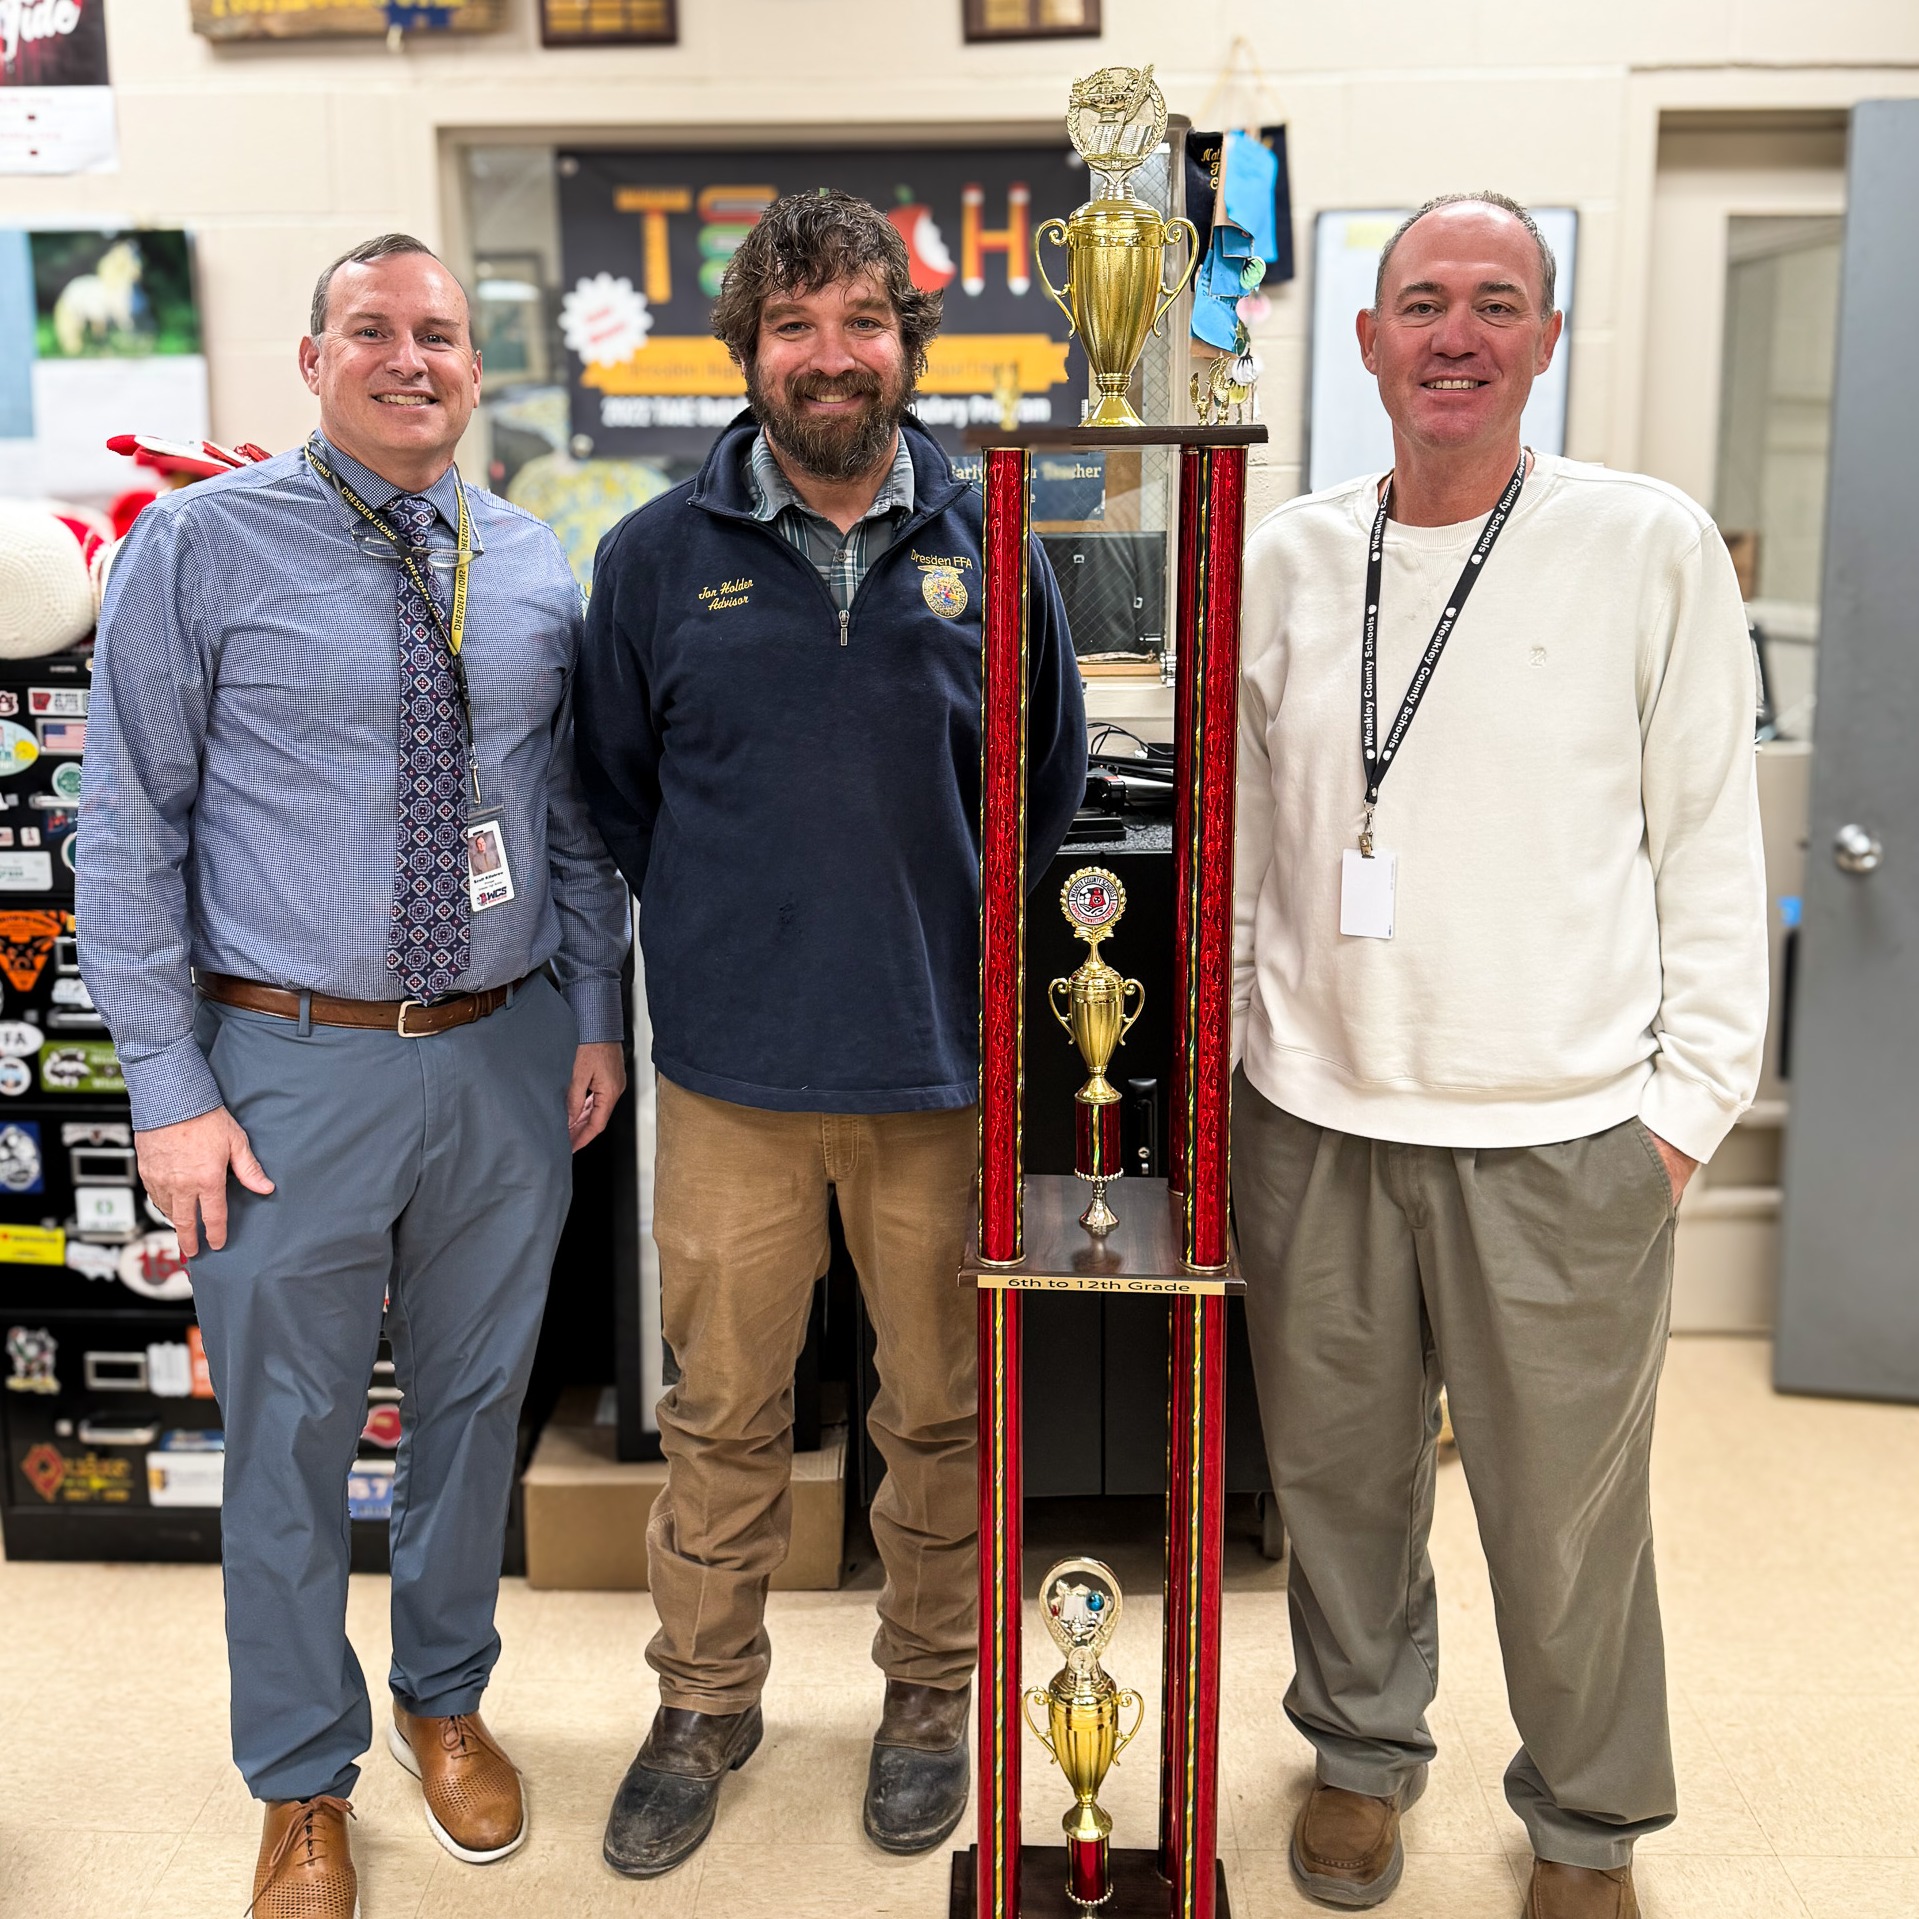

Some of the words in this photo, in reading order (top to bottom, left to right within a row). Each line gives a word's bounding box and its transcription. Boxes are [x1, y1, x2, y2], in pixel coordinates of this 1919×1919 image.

[341, 486, 374, 521] DRESDEN
[373, 514, 398, 542] LIONS
[1498, 478, 1521, 512] County
[1371, 510, 1386, 550] Weakley
[1478, 512, 1504, 552] Schools
[404, 556, 430, 601] DRESDEN
[910, 548, 951, 566] Dresden
[953, 556, 973, 570] FFA
[708, 596, 749, 610] Advisor
[1365, 616, 1374, 658] Schools
[1424, 620, 1452, 666] Weakley
[1364, 660, 1374, 698] County
[1406, 667, 1430, 704] County
[1364, 701, 1374, 747] Weakley
[1388, 706, 1413, 749] Schools
[1008, 1278, 1042, 1288] 6th
[1048, 1280, 1069, 1288] to
[1077, 1280, 1121, 1290] 12th
[1128, 1282, 1190, 1292] Grade
